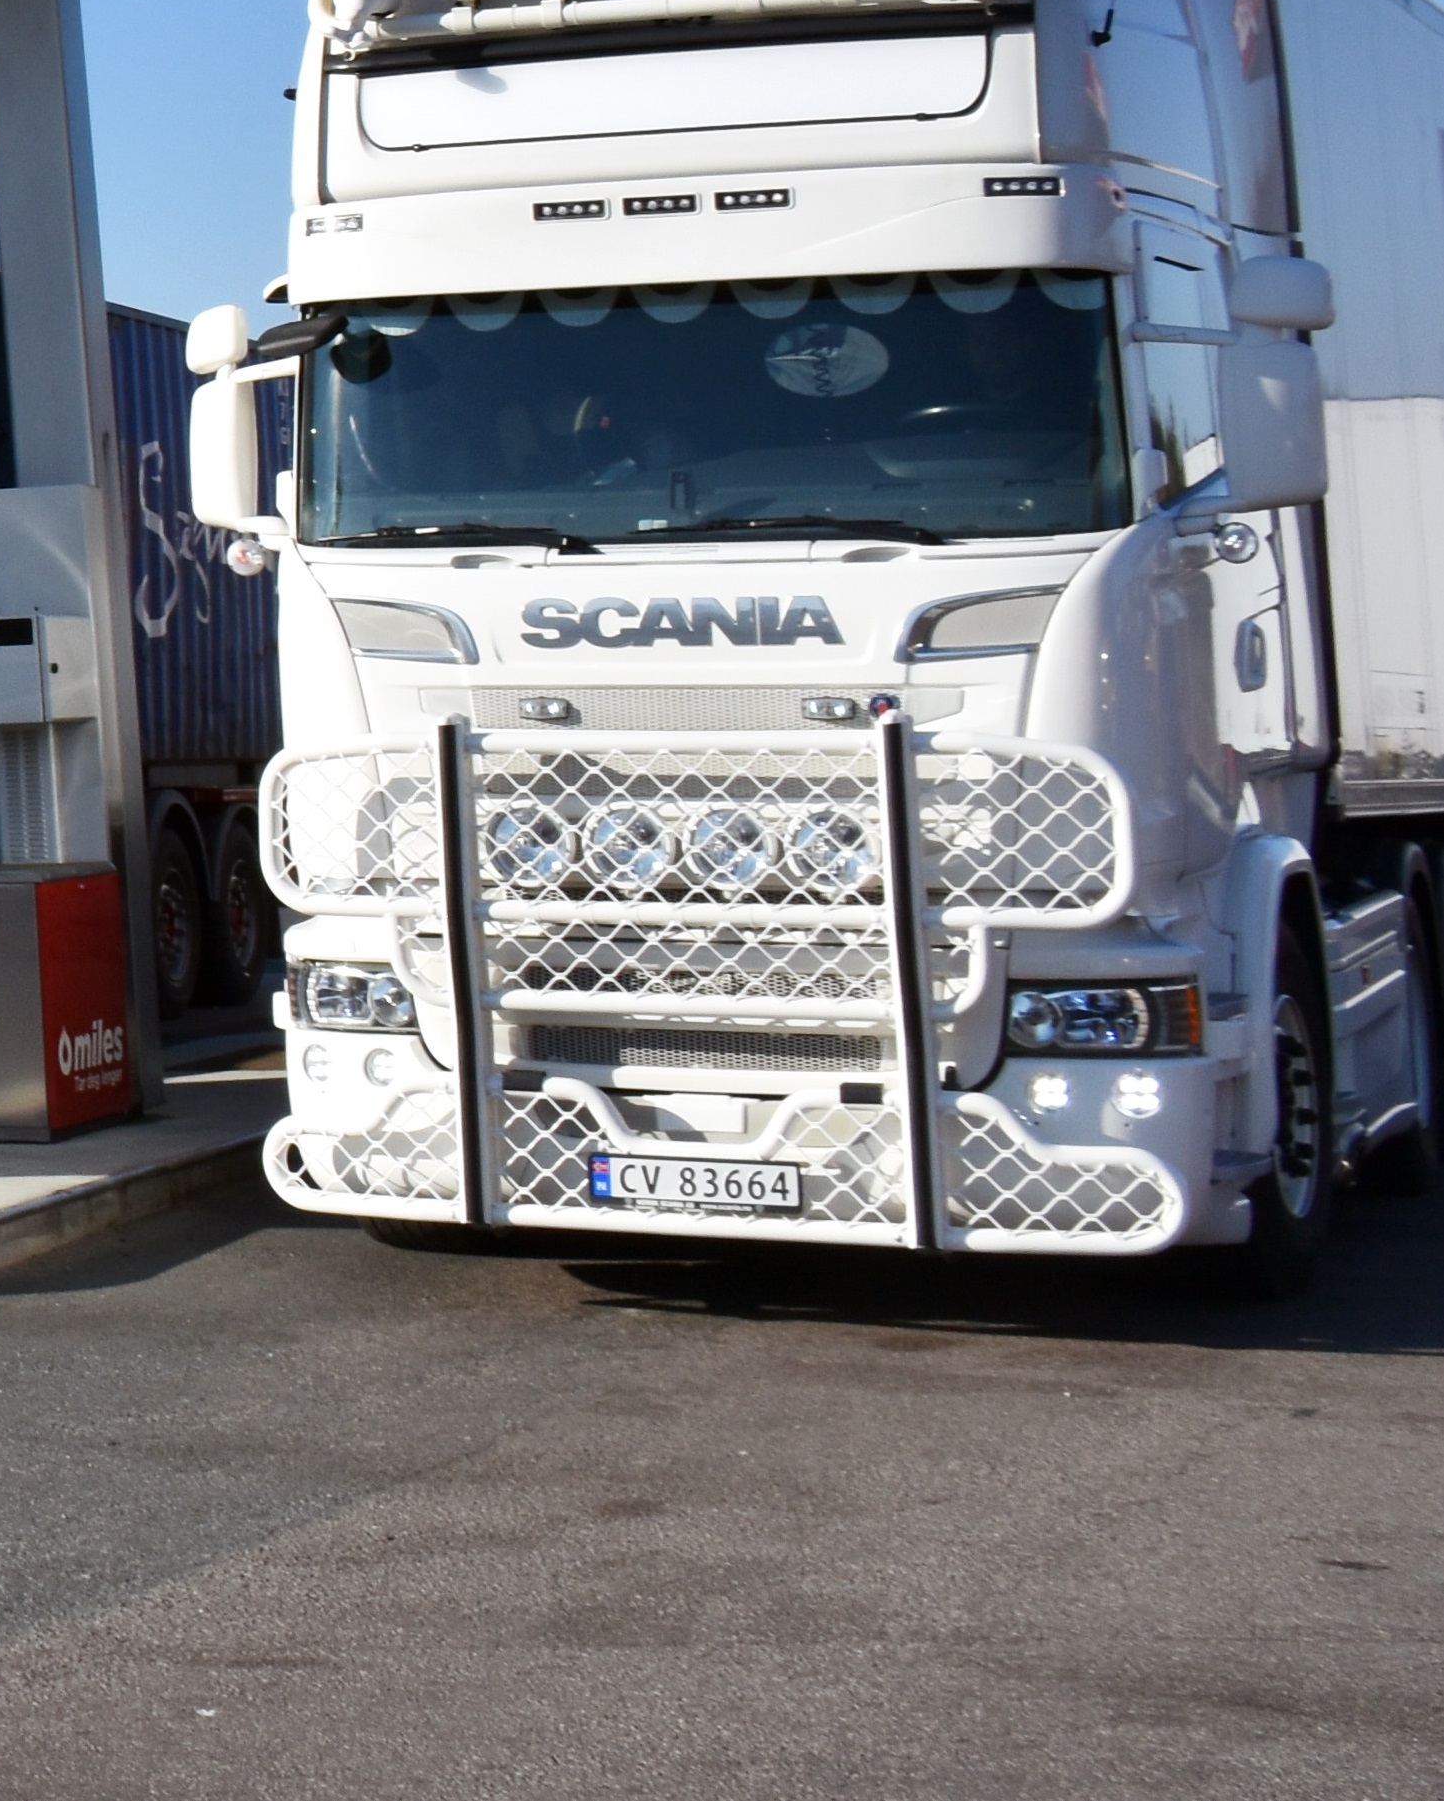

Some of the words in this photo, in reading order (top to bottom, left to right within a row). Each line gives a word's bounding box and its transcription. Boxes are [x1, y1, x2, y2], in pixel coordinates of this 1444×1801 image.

[519, 594, 847, 650] SCANIA
[73, 1018, 123, 1072] miles
[619, 1163, 661, 1195] CV
[678, 1166, 790, 1202] 83664
